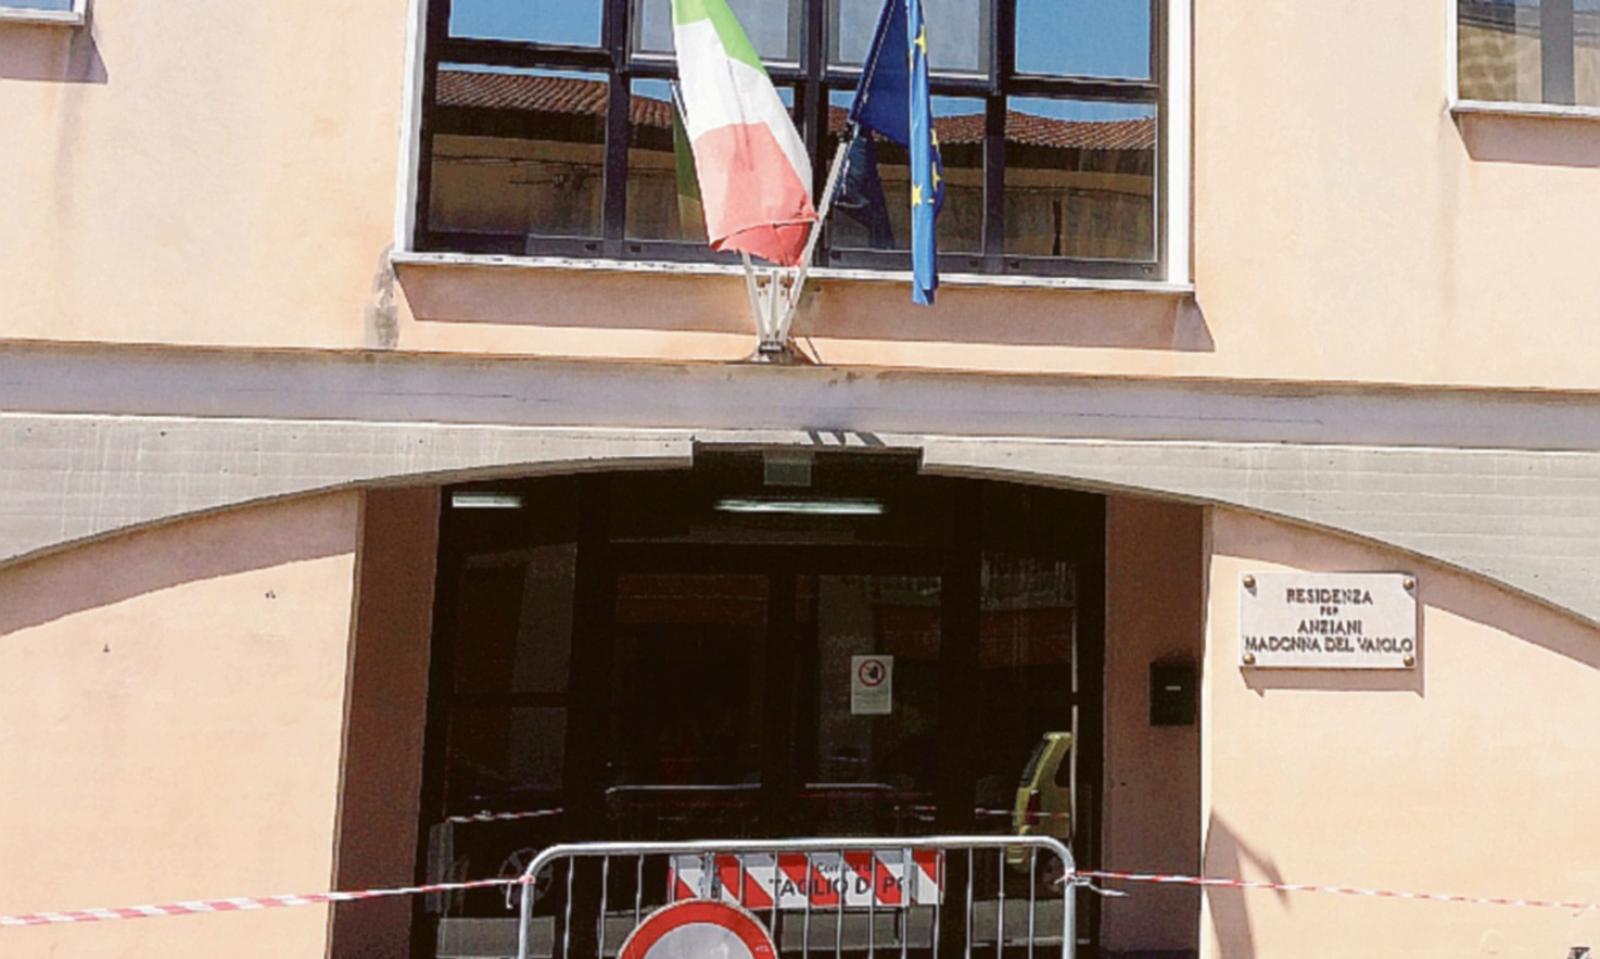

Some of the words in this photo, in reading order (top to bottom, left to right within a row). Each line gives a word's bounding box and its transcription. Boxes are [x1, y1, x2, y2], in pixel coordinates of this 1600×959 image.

[1286, 587, 1373, 605] RESIDENZA
[1297, 619, 1362, 635] ANZIANI
[1324, 636, 1355, 653] DEL
[1356, 636, 1413, 653] VAIOLO
[855, 876, 872, 895] D
